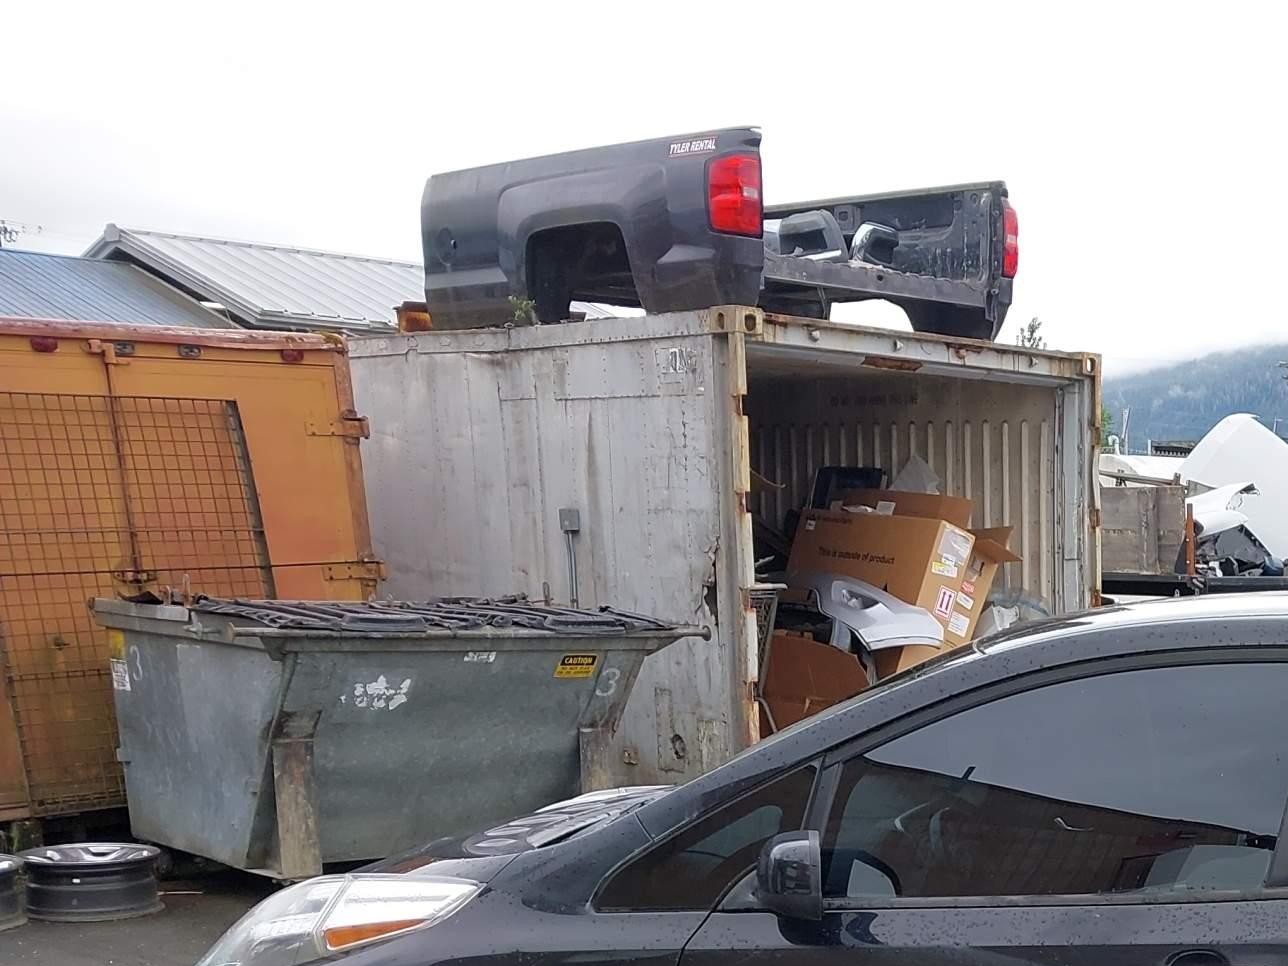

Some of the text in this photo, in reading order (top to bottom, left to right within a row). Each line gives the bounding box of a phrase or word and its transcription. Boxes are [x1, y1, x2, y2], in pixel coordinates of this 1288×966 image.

[669, 138, 716, 155] TYLER RENTAL
[868, 552, 895, 565] product
[564, 656, 593, 665] CAUTION
[595, 667, 621, 697] 3
